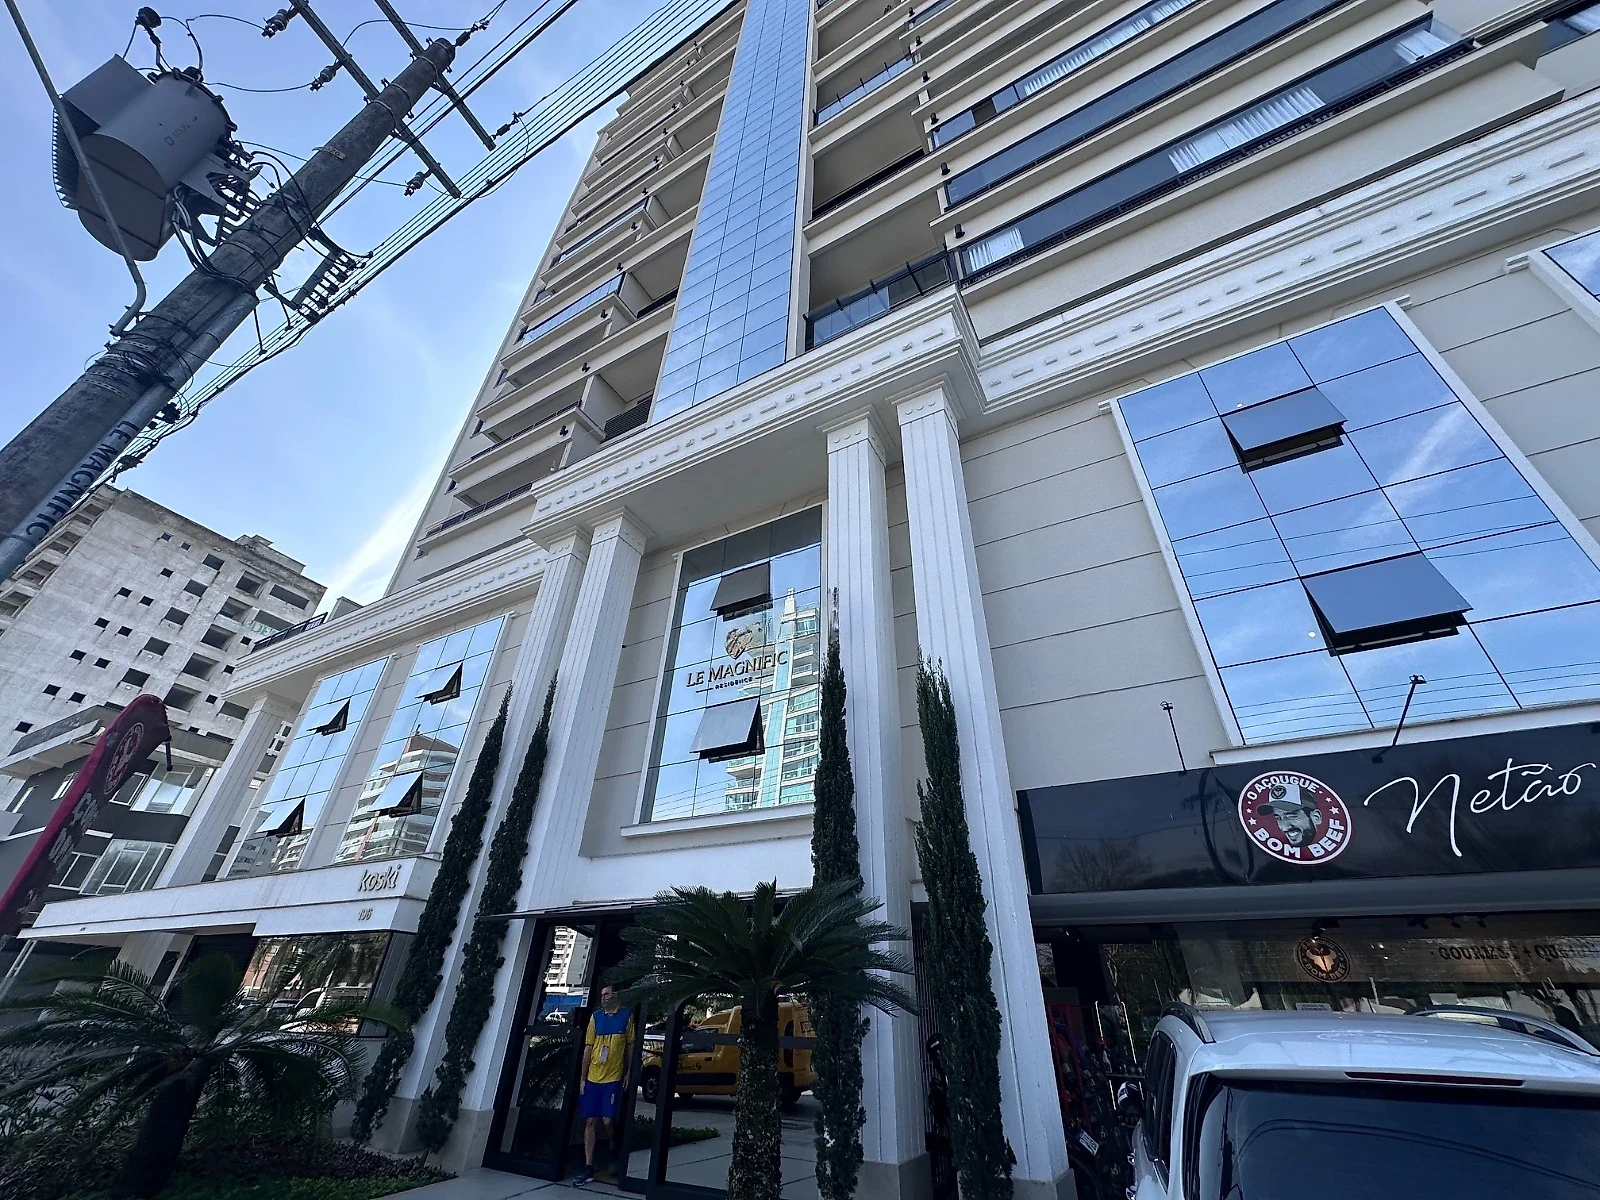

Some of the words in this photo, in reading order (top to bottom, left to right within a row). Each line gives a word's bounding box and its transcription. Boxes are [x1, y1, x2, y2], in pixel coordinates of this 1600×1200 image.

[109, 420, 140, 444] LE
[26, 443, 119, 539] MAGNIFIC
[686, 671, 705, 688] LE
[708, 650, 788, 683] MAGNIFIC
[715, 676, 753, 690] RESIDENCE
[1246, 791, 1258, 801] O
[1254, 775, 1320, 794] AÇOUGUE
[1363, 757, 1597, 858] Netão
[1253, 827, 1301, 859] BOM
[1307, 818, 1345, 858] BEEF
[358, 863, 402, 892] koski
[1305, 963, 1327, 980] BOM
[1329, 962, 1346, 980] BEEF
